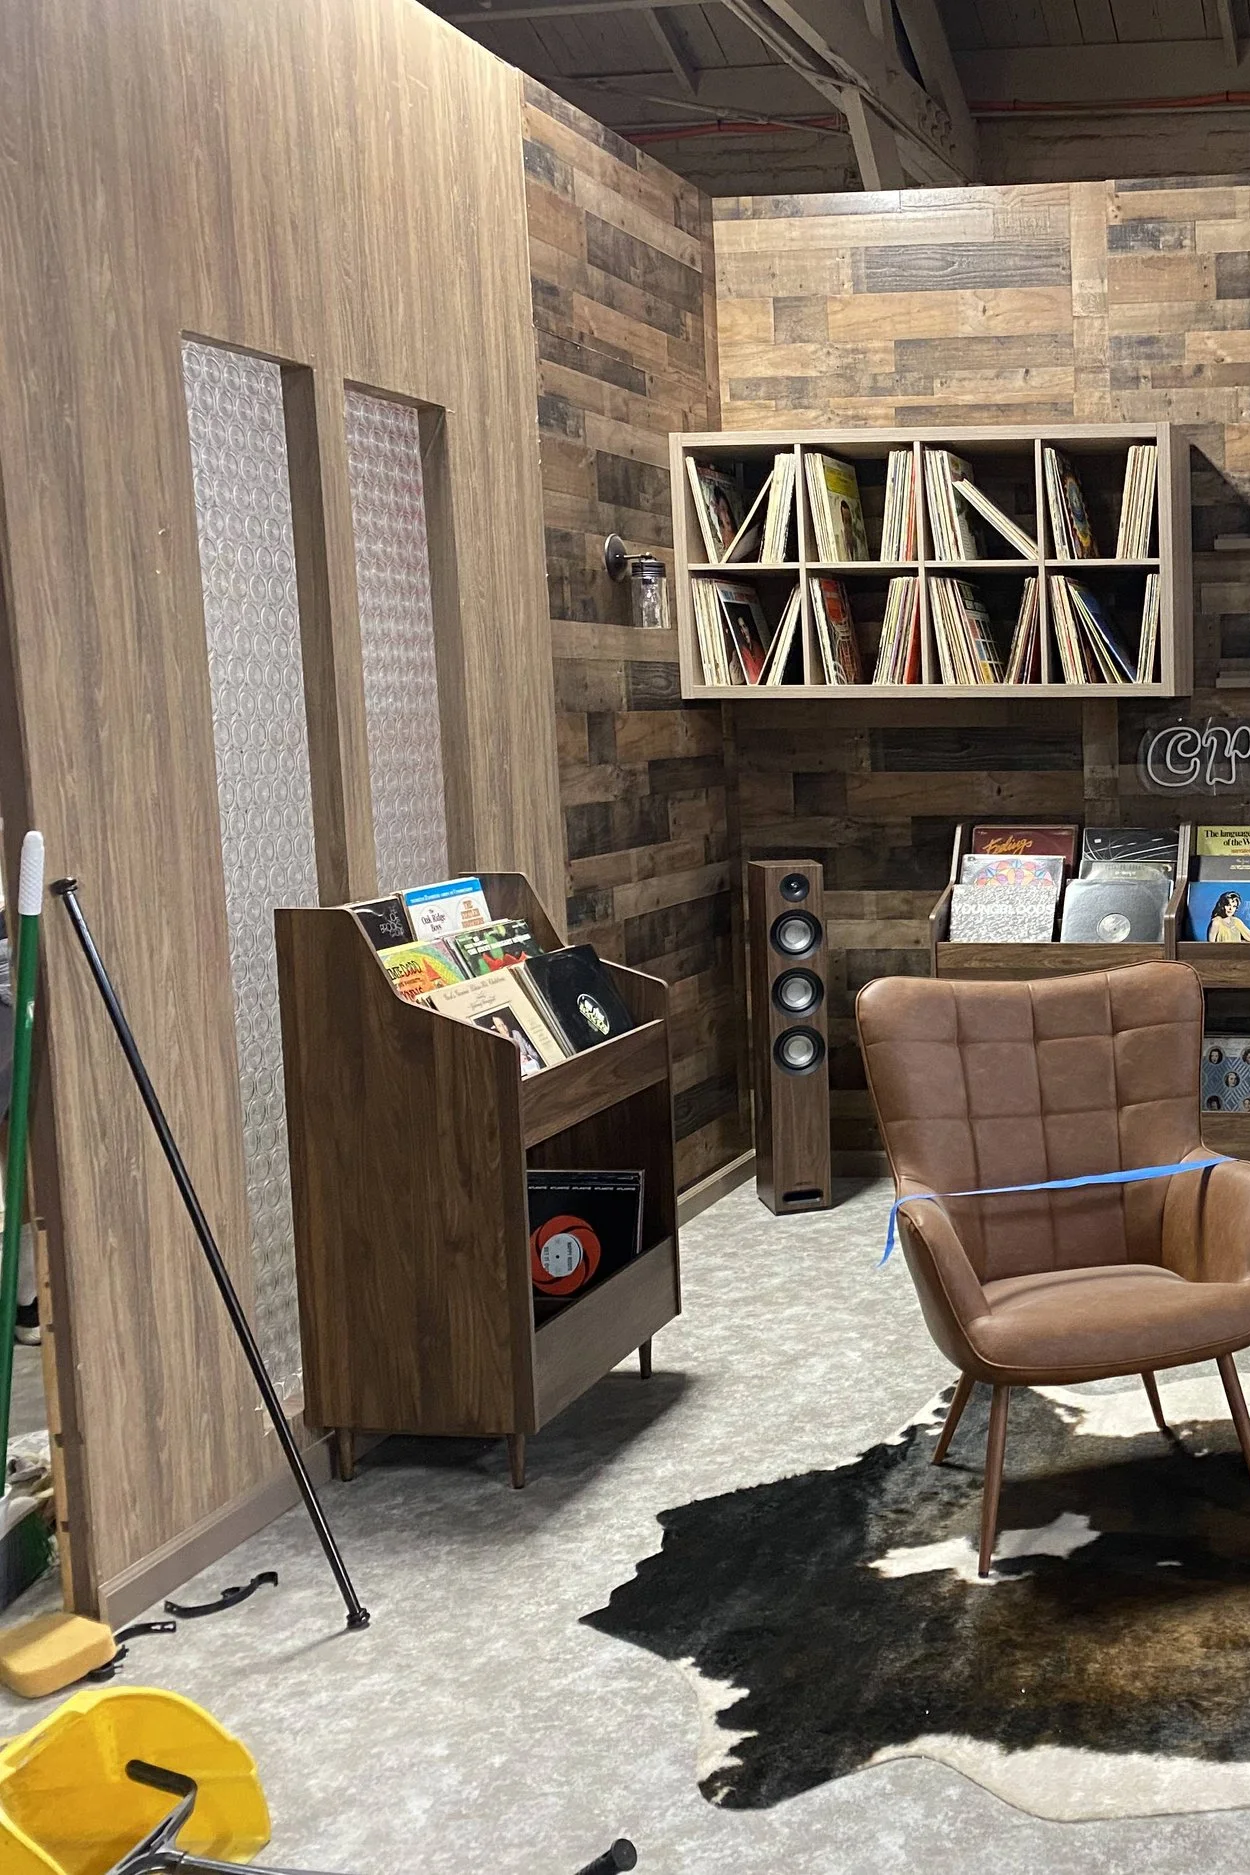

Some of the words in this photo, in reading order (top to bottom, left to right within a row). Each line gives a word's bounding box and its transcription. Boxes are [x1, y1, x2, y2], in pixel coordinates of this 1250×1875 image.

[1204, 829, 1219, 838] The
[1223, 838, 1231, 846] of
[1231, 838, 1243, 846] the
